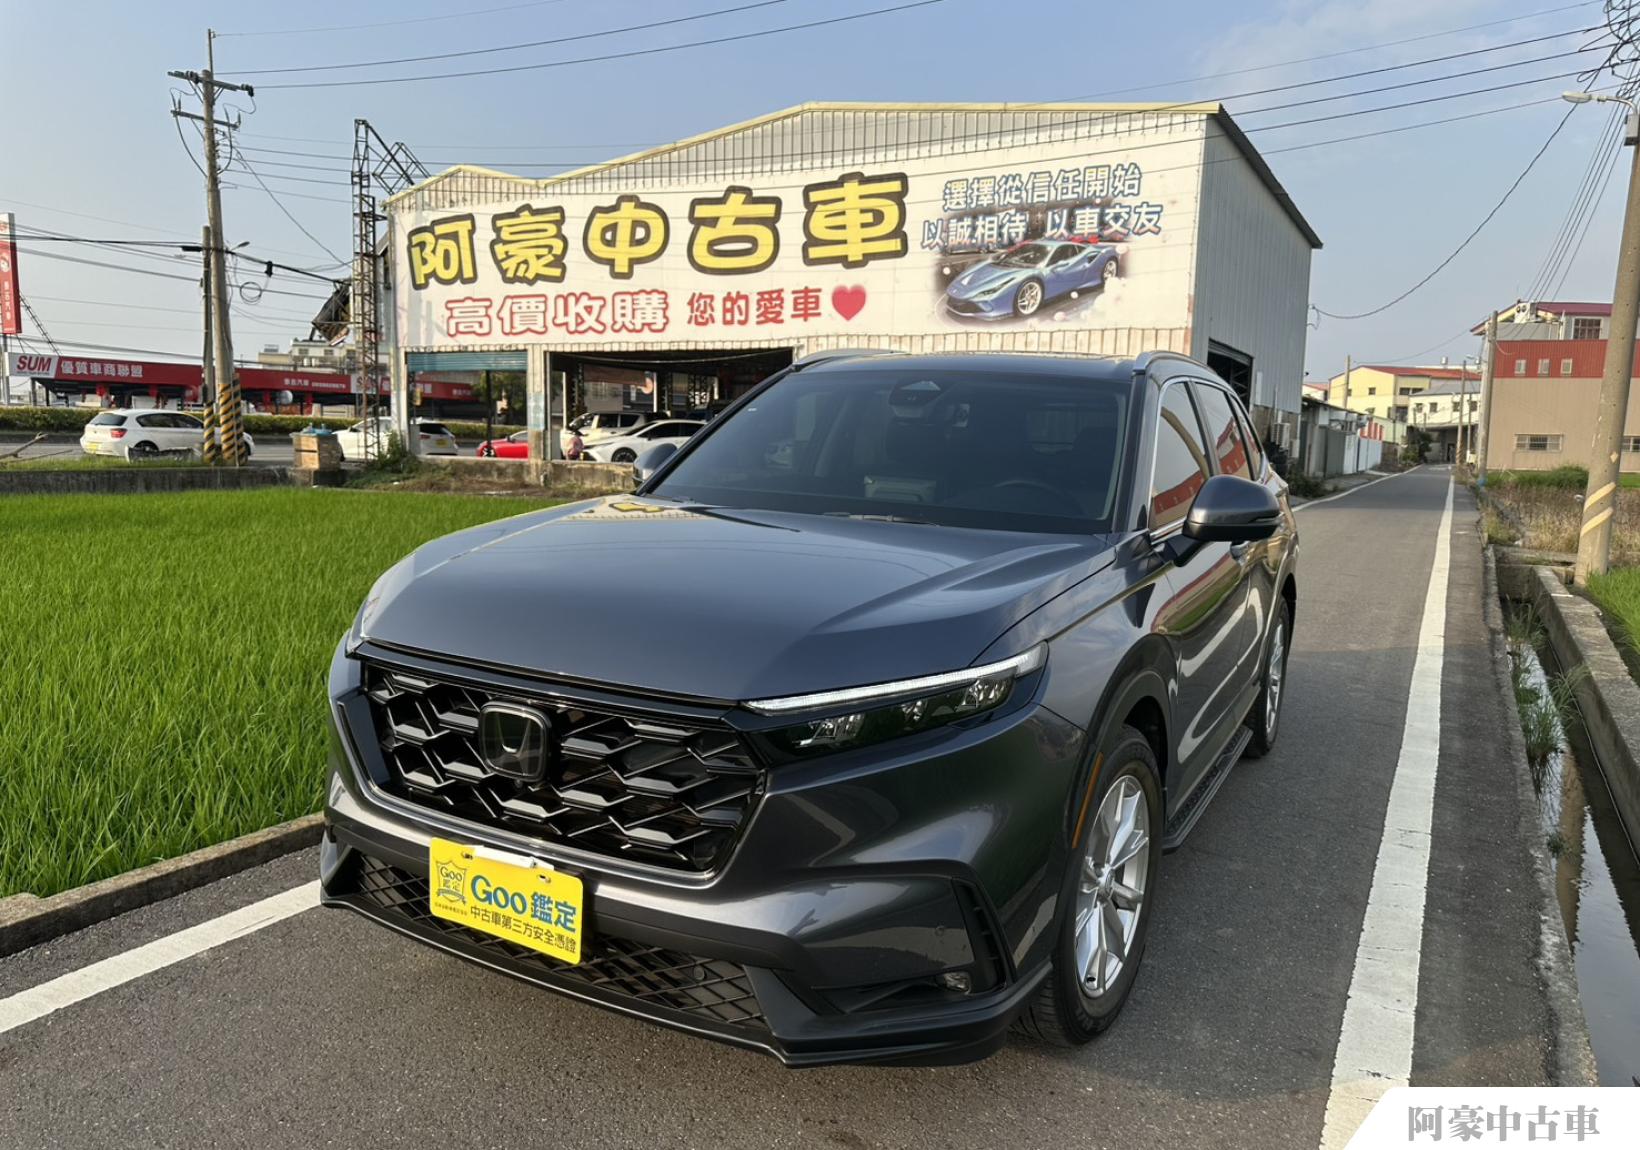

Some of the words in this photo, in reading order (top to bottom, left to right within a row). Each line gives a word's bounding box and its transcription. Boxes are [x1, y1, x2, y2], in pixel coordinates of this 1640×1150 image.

[943, 163, 1142, 211] 選擇從信任開始
[407, 172, 908, 290] 阿豪中古車
[921, 210, 1027, 250] 以誠相待
[1044, 202, 1163, 240] 以車交友
[446, 290, 669, 337] 高價收購
[687, 286, 823, 326] 您的愛車
[17, 356, 52, 371] SUM
[61, 361, 143, 377] 優質車商聯盟
[440, 867, 463, 882] Goo
[471, 875, 527, 915] Goo
[531, 892, 576, 933] 鑑定
[470, 906, 577, 954] 中古車第三方安全憑證
